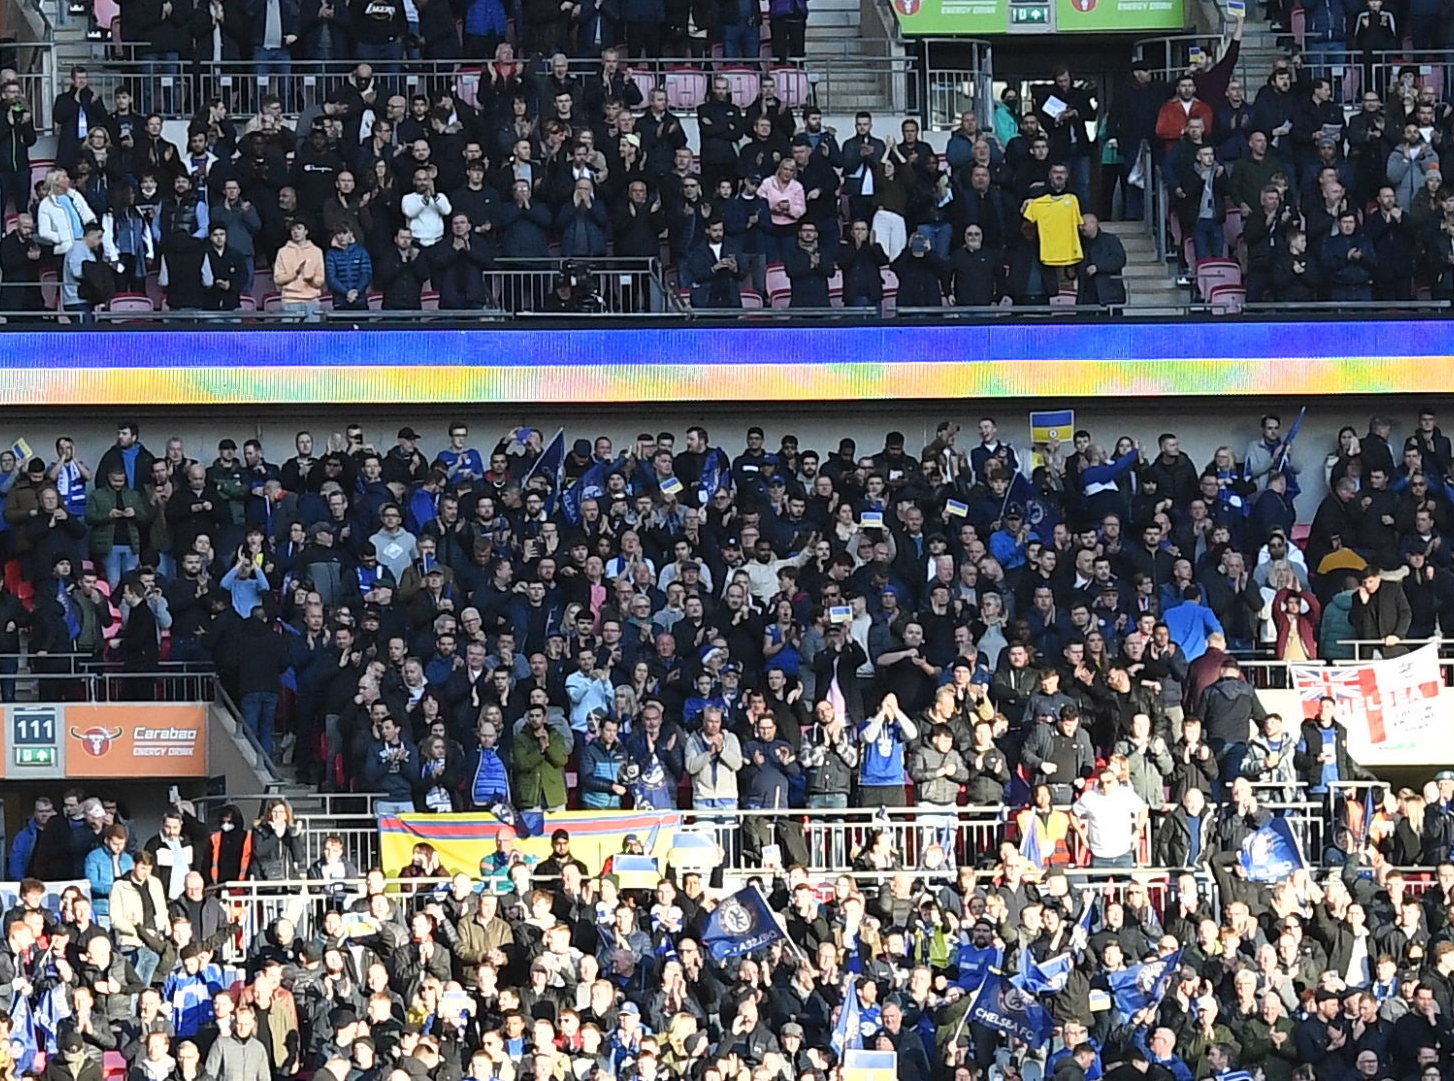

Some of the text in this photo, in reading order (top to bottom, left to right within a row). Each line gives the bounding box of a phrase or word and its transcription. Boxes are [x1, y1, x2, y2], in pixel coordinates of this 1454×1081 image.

[17, 720, 54, 739] 111
[133, 727, 198, 740] Carabao
[1019, 1026, 1034, 1041] FC
